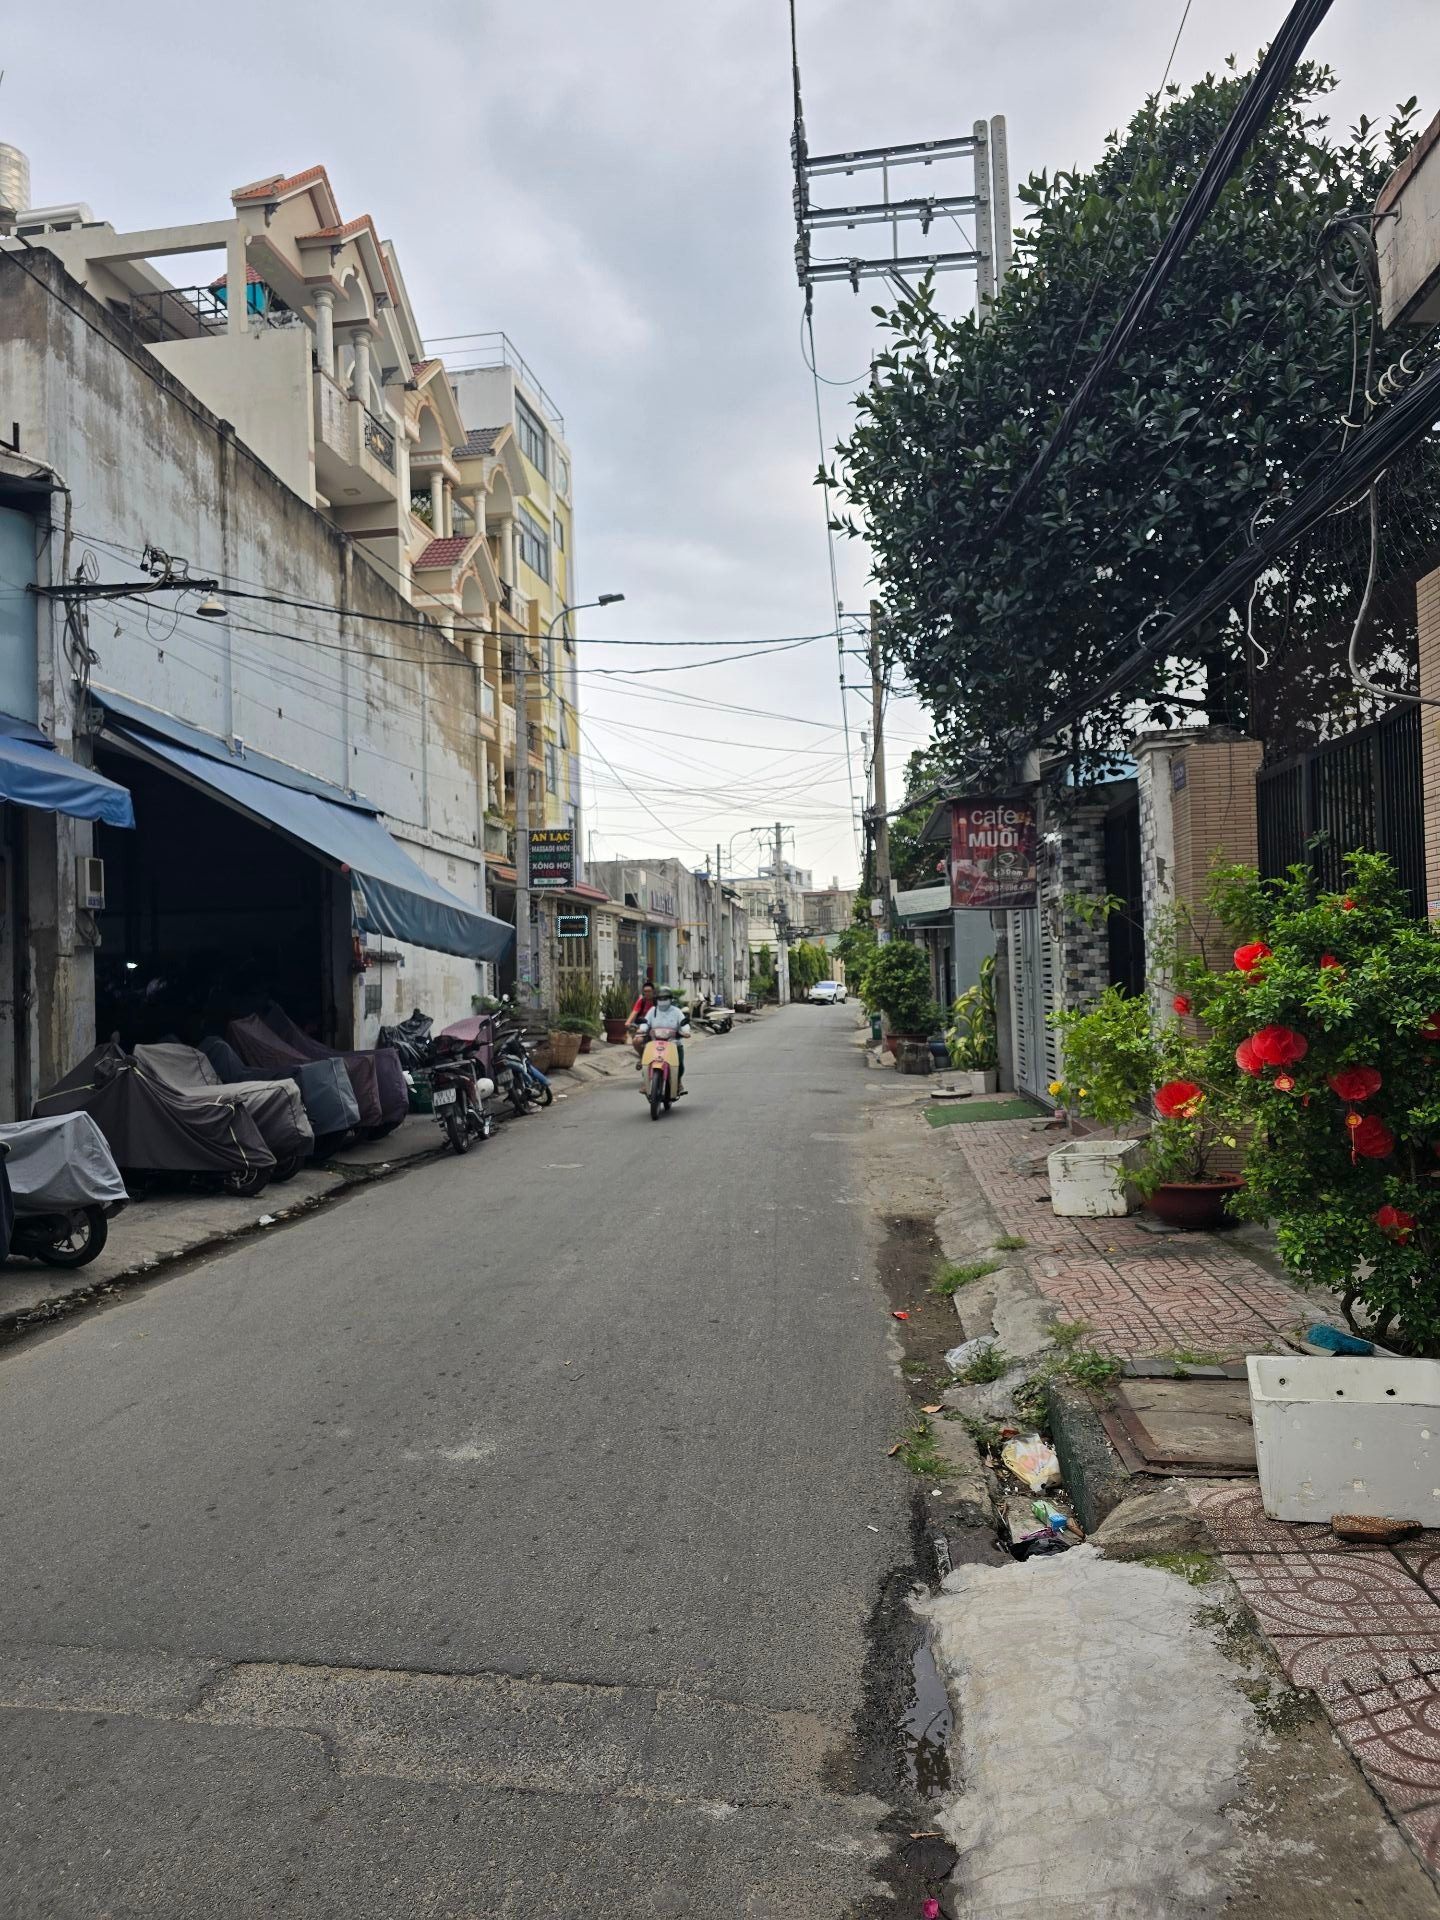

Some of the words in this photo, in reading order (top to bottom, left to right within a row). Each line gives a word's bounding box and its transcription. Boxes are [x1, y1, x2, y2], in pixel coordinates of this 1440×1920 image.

[970, 805, 1017, 825] cafe
[531, 833, 547, 842] AN
[550, 832, 570, 844] LẠC
[531, 845, 555, 853] MASSAGE
[532, 861, 555, 870] XÔNG
